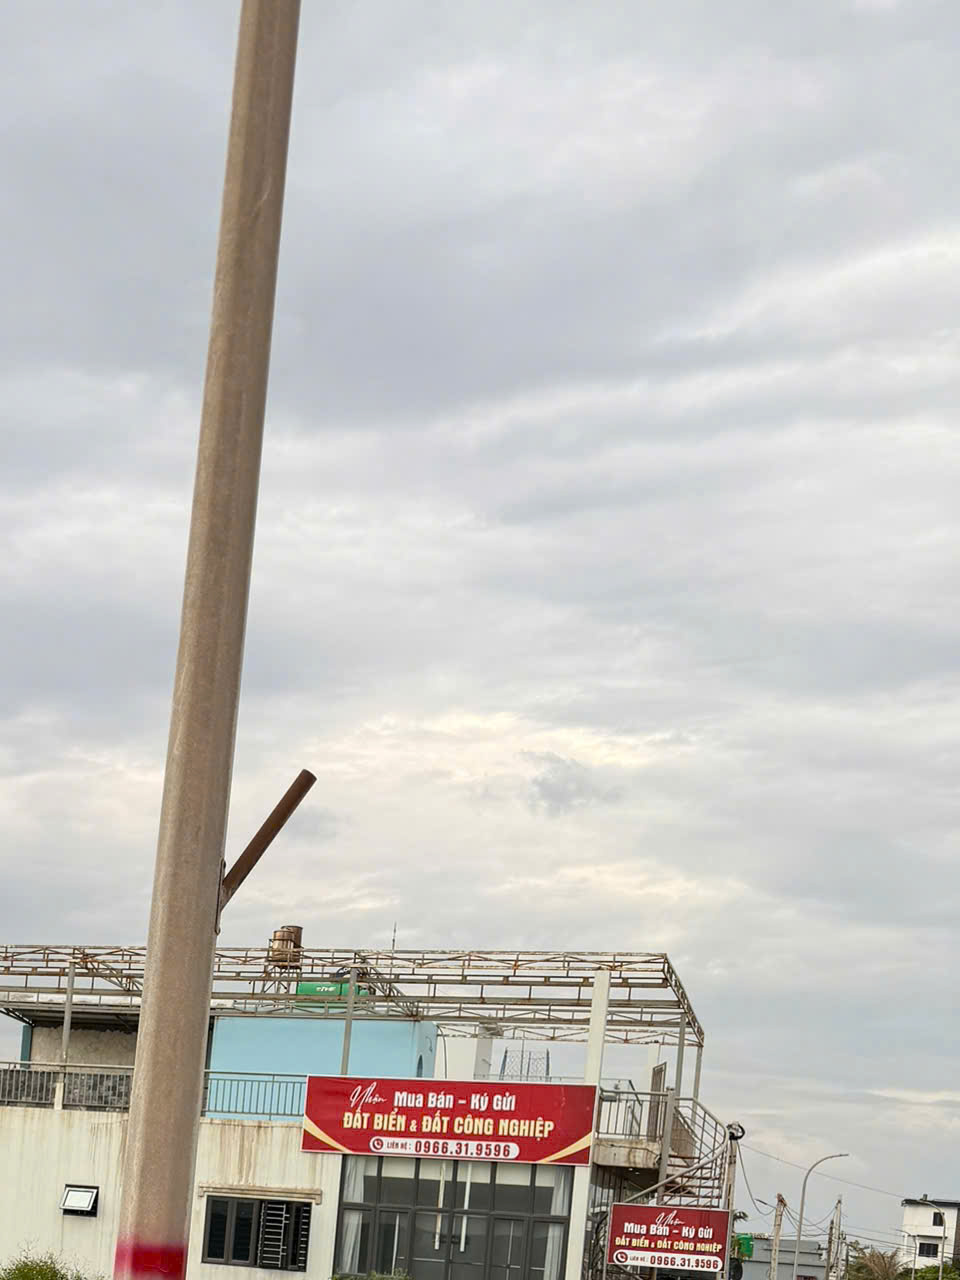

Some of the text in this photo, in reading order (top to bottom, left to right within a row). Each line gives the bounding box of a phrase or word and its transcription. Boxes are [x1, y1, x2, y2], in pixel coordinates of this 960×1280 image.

[393, 1091, 423, 1107] Mua
[428, 1091, 454, 1109] Bán
[470, 1093, 489, 1112] Ký
[492, 1091, 516, 1111] Gửi
[343, 1108, 554, 1142] ĐẤT BIỂN & ĐẤT CÔNG NGHIỆP
[414, 1140, 511, 1157] 0966.31.9596
[624, 1222, 646, 1234] Mua
[649, 1224, 670, 1236] Bán
[681, 1226, 696, 1239] Ký
[698, 1225, 713, 1239] Gửi
[615, 1235, 629, 1246] ĐẤT
[656, 1237, 672, 1249] ĐẤT
[673, 1239, 694, 1251] CÔNG
[696, 1243, 722, 1253] NGHIỆP
[650, 1255, 719, 1270] 0966.31.9596
